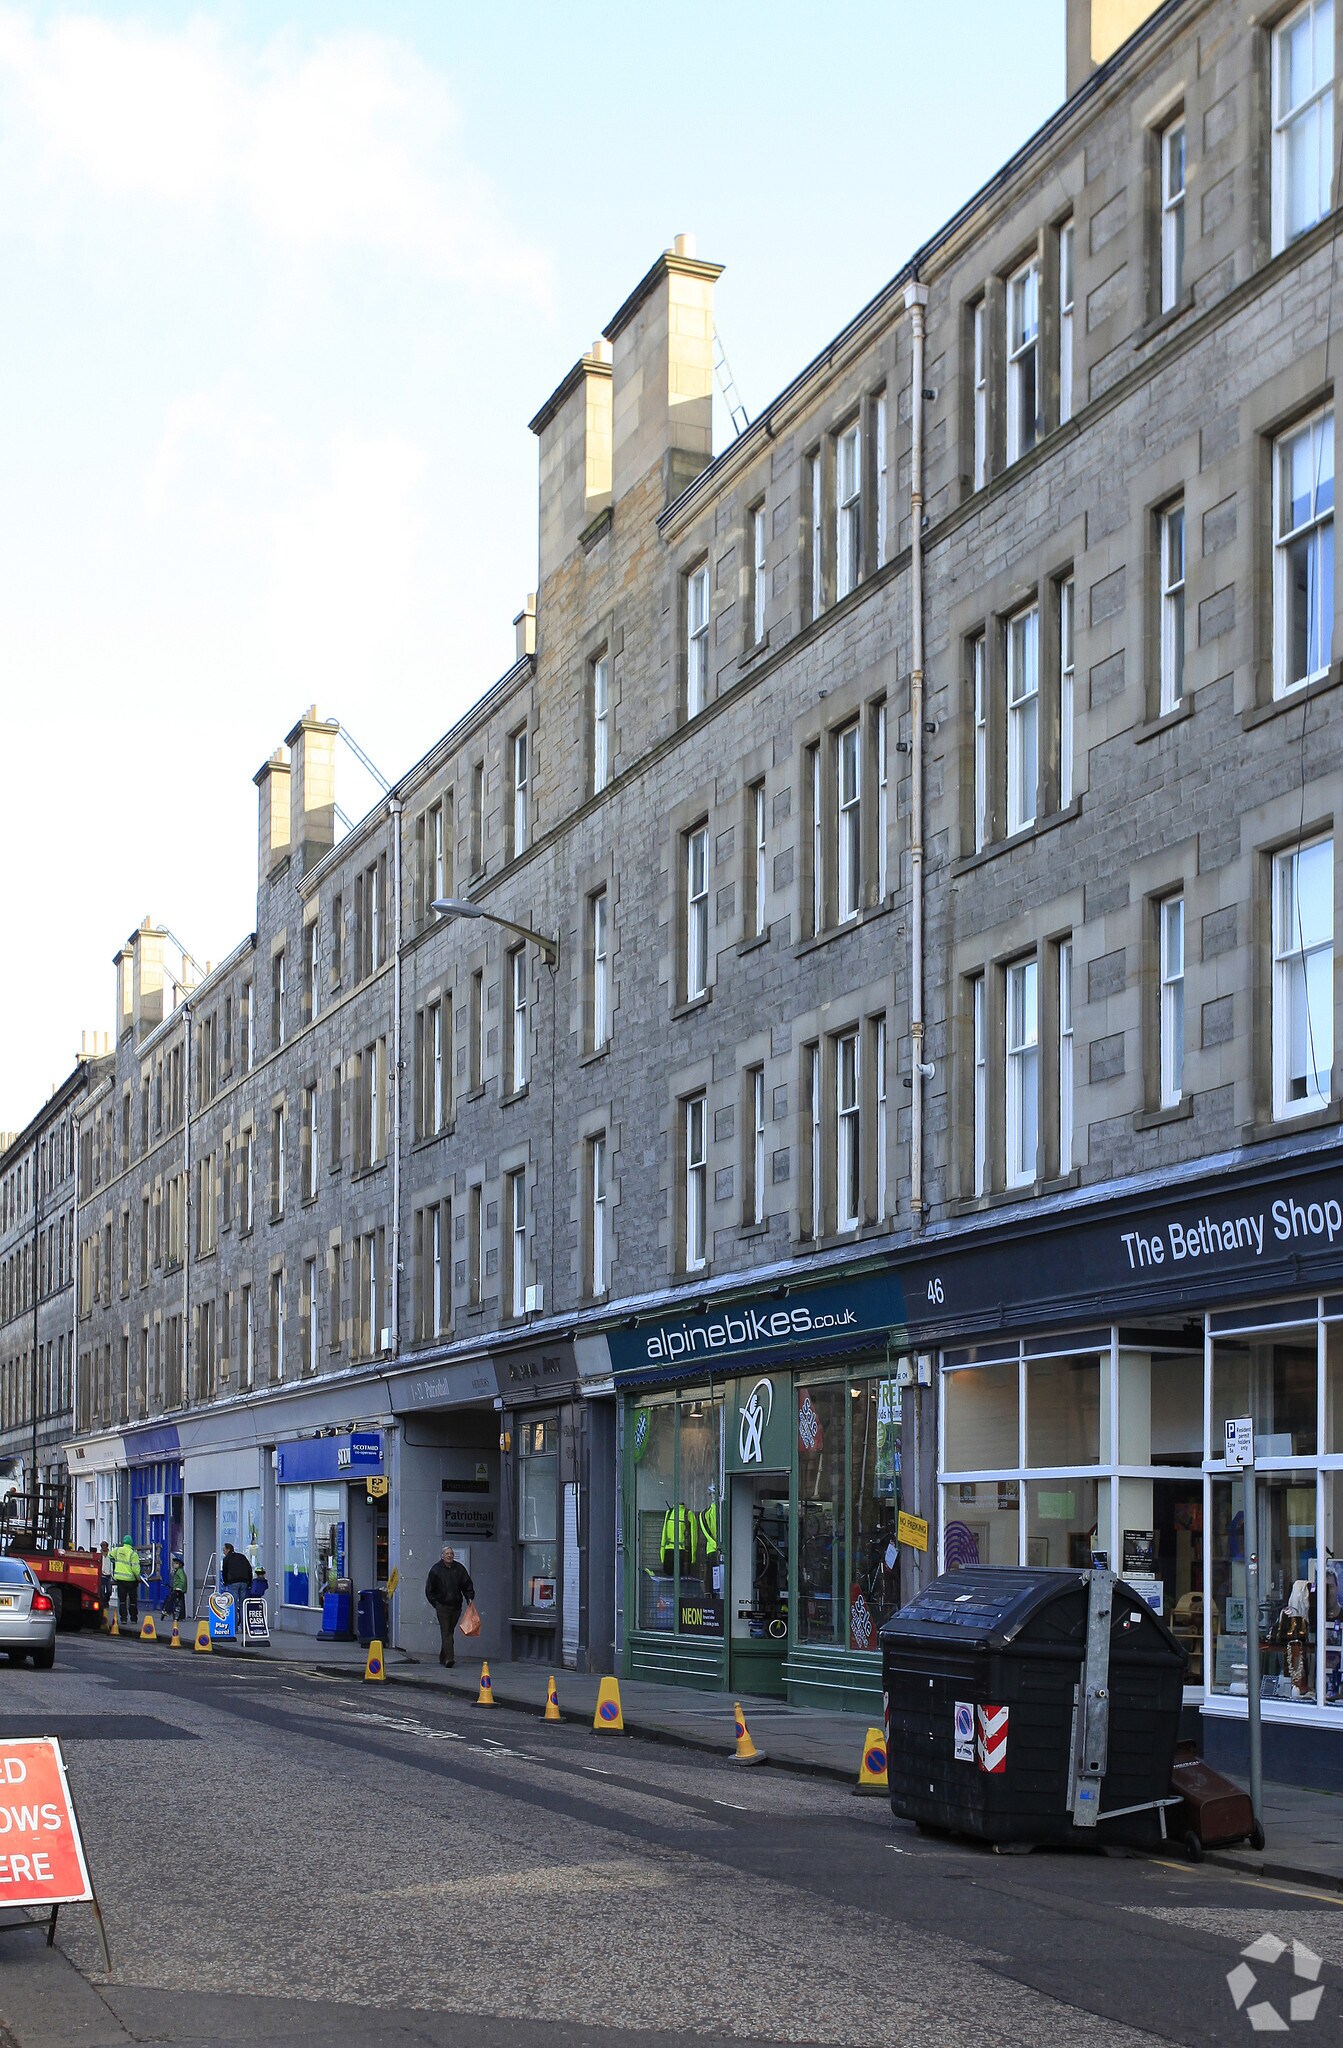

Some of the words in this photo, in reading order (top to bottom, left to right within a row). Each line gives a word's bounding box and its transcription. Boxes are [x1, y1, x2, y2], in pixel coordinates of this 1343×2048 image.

[1121, 1232, 1164, 1269] The
[1168, 1214, 1264, 1260] Bethany
[1271, 1198, 1342, 1242] Shop
[926, 1278, 945, 1304] 46
[646, 1307, 857, 1360] alpinebikes.co.uk
[543, 1356, 561, 1373] ART
[802, 1397, 818, 1437] Sale
[1228, 1423, 1235, 1438] P
[445, 1510, 494, 1521] Patriothall
[900, 1517, 906, 1526] NO
[907, 1519, 926, 1534] PARKING
[682, 1607, 703, 1625] NEON
[855, 1594, 872, 1637] Sale
